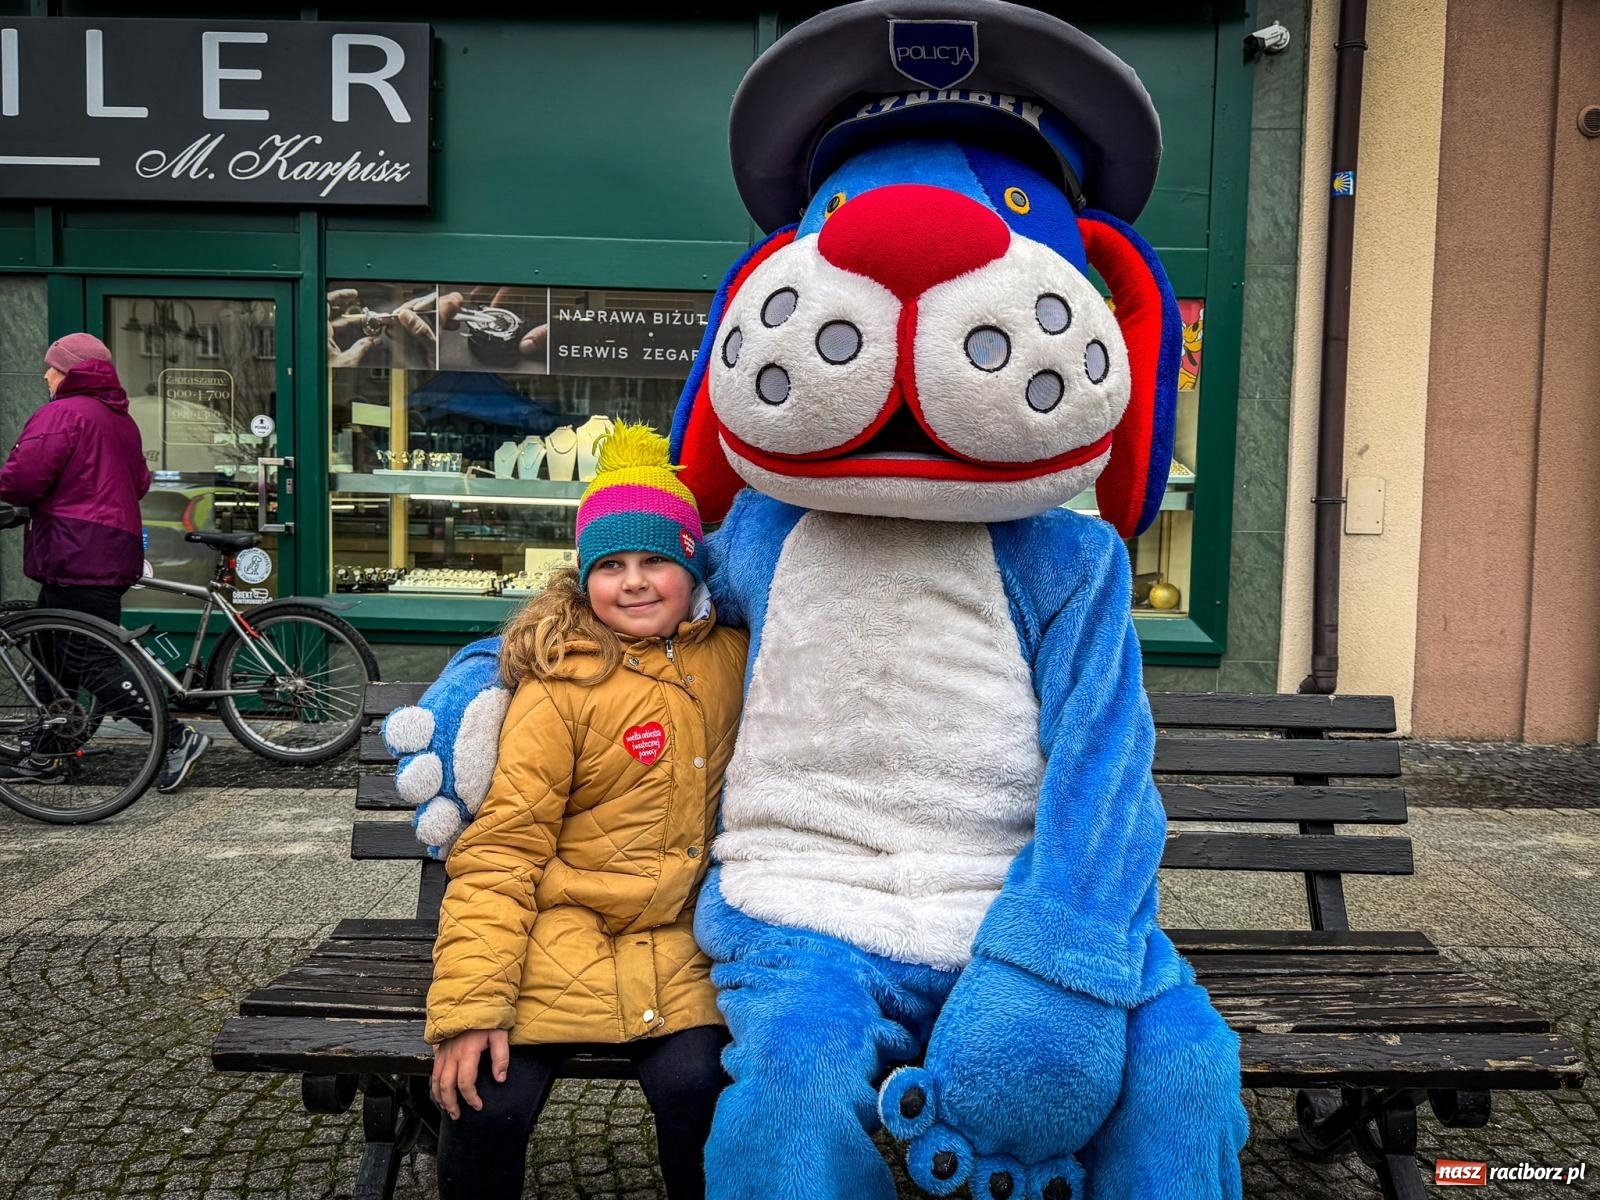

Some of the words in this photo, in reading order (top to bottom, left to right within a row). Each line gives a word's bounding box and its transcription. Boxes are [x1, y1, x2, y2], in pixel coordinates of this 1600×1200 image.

[896, 45, 973, 66] POLICJA
[136, 133, 226, 180] M.
[228, 134, 411, 197] Karpisz
[559, 309, 646, 324] NAPRAWA
[558, 345, 629, 360] SERWIS
